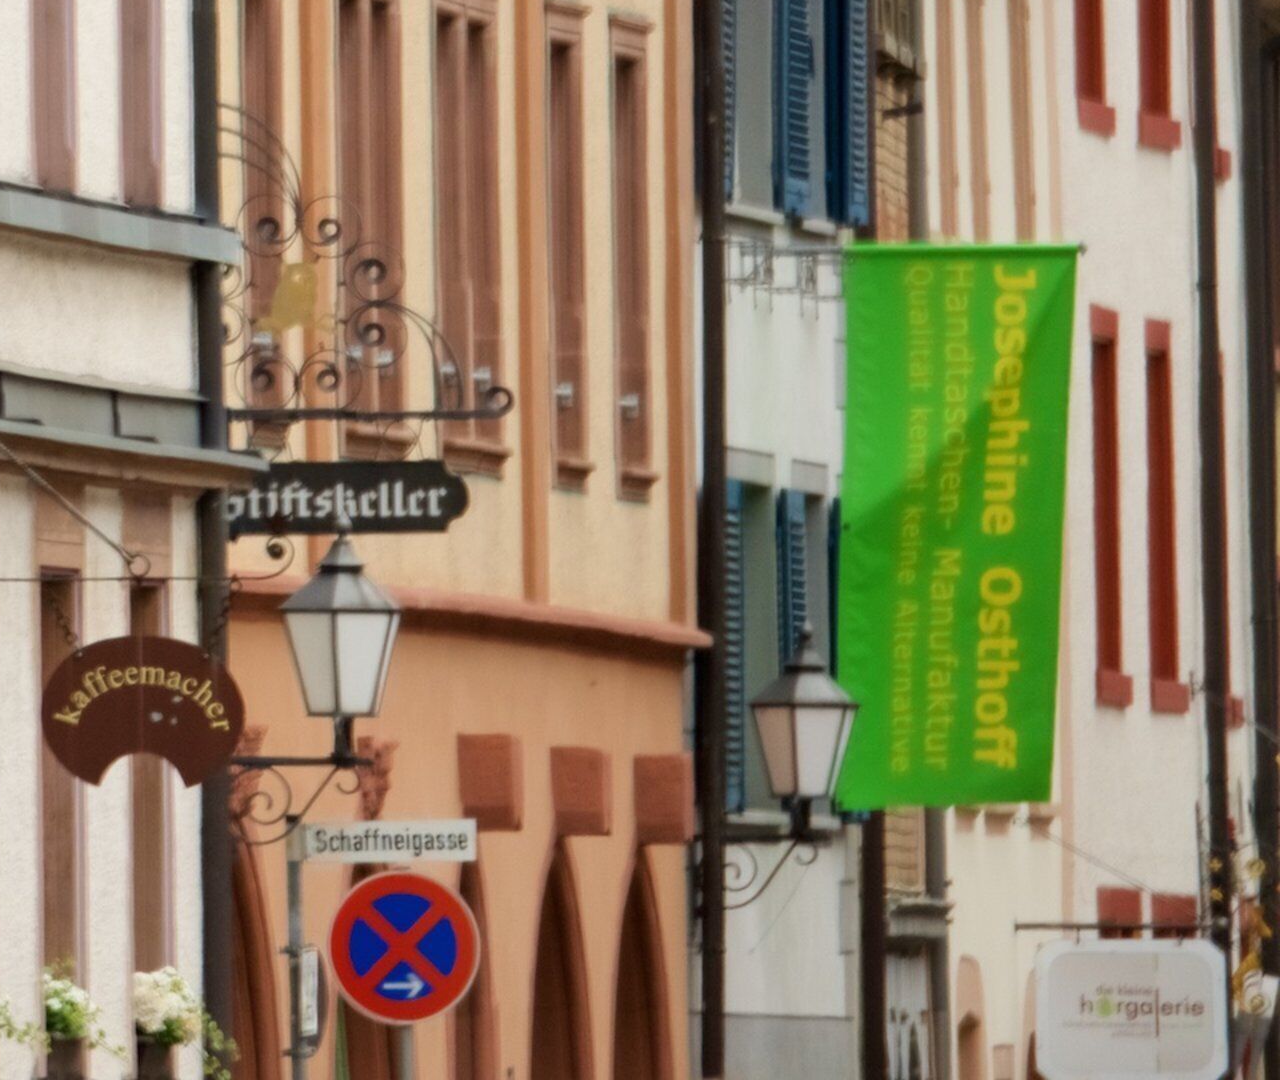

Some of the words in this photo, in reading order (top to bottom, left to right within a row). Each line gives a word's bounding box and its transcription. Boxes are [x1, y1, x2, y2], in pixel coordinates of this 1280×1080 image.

[905, 407, 933, 491] kennt
[981, 263, 1037, 534] Josephine
[896, 506, 925, 585] keine
[52, 665, 231, 732] kaffeemacher
[891, 600, 919, 773] Alternative
[924, 548, 962, 770] Manufaktur
[973, 566, 1022, 770] Osthoff
[314, 827, 469, 857] Schaffneigasse
